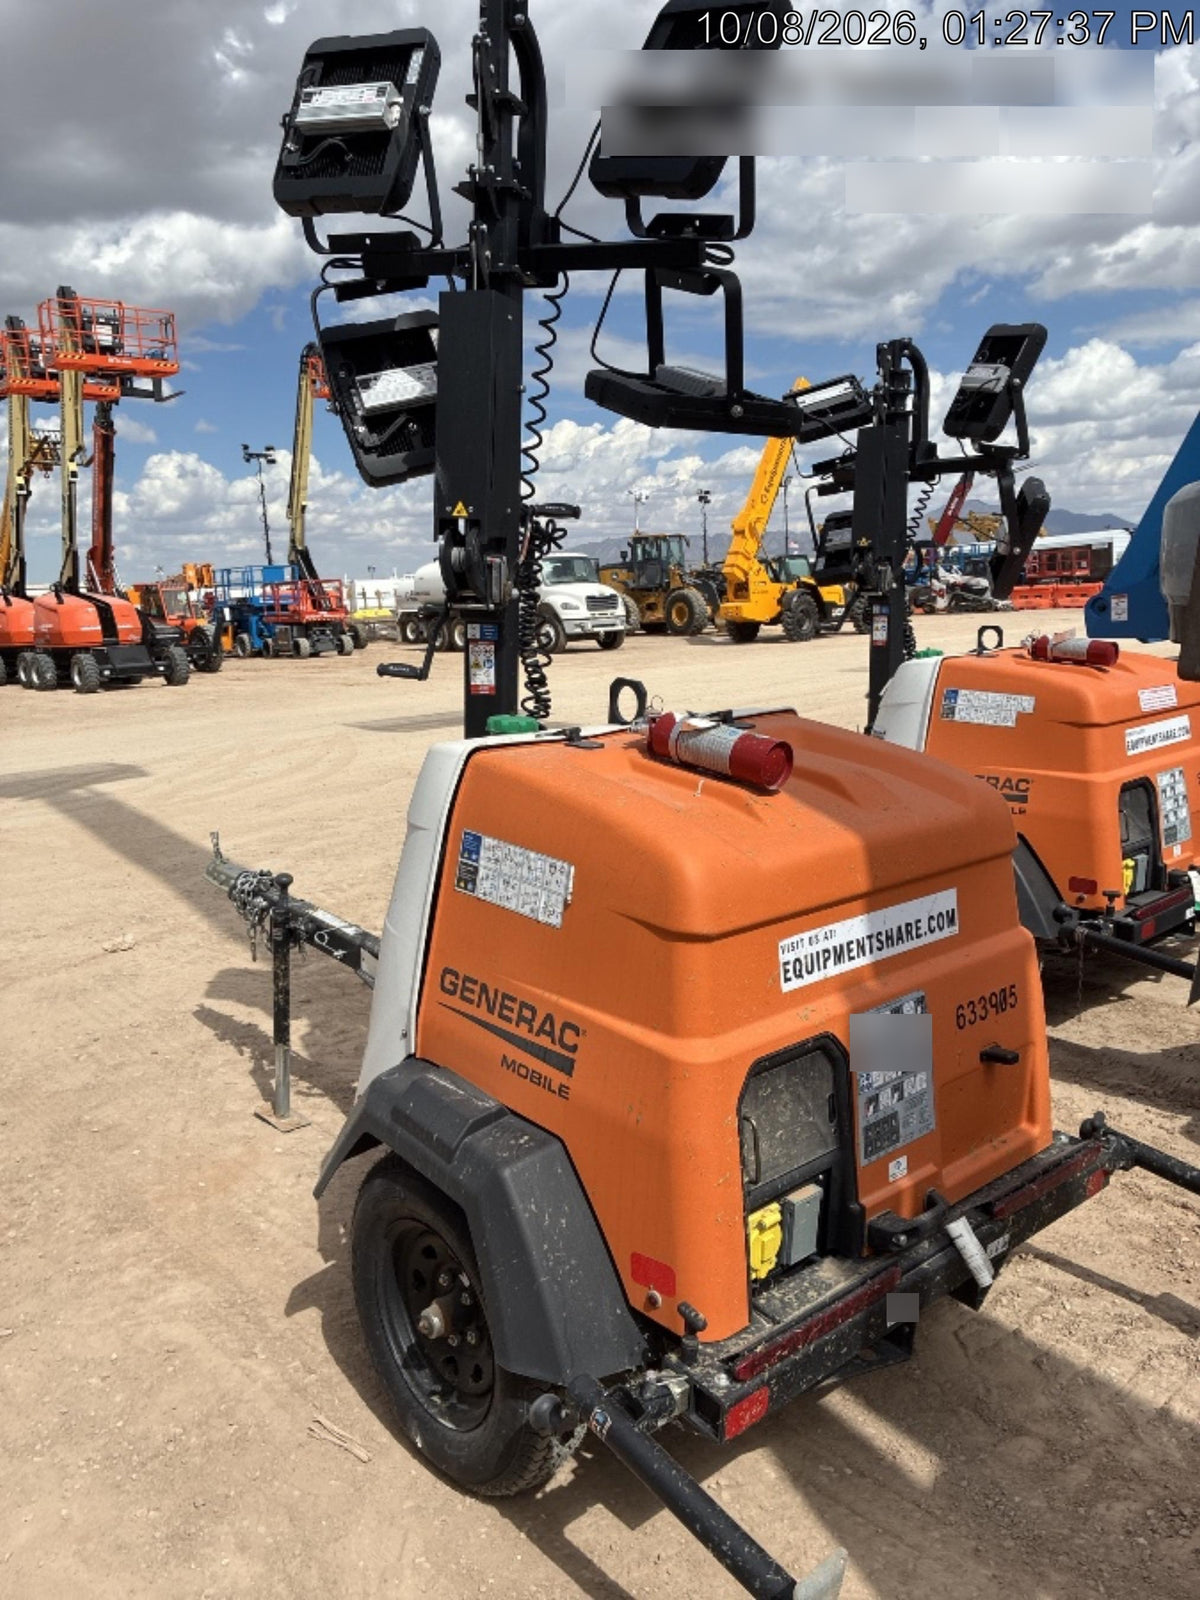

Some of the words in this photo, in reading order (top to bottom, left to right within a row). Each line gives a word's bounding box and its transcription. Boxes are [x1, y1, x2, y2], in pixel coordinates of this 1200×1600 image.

[780, 937, 804, 955] VISIT
[783, 908, 956, 984] EQUIPMENTSHARE.COM
[439, 966, 581, 1054] GENERAC
[955, 984, 1018, 1030] 633905
[500, 1053, 571, 1101] MOBILE
